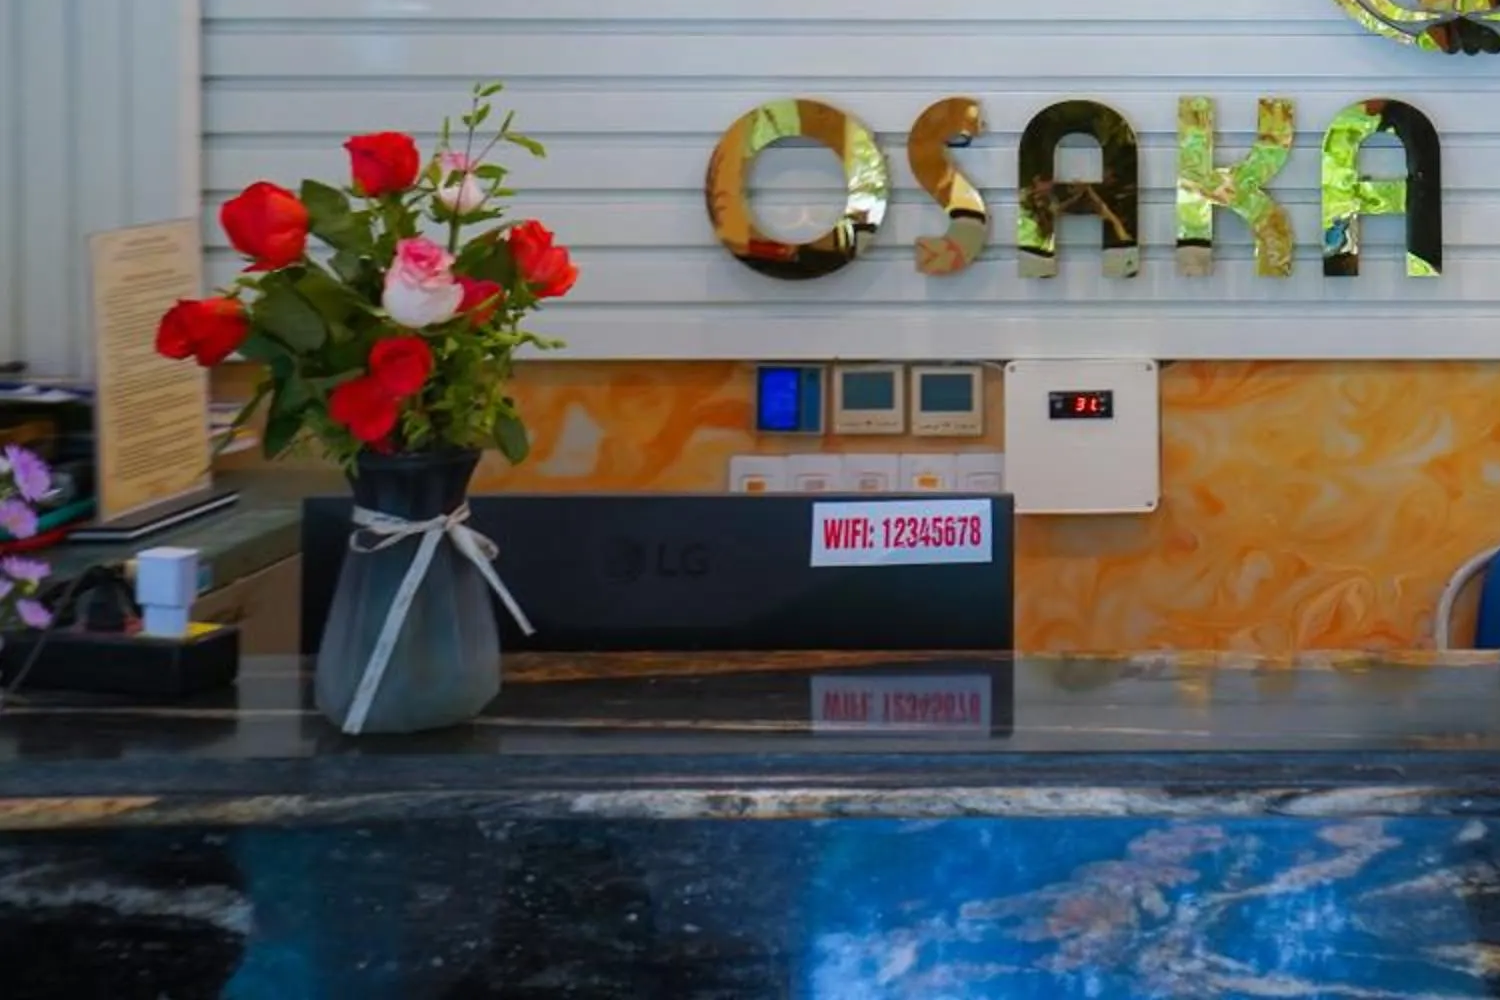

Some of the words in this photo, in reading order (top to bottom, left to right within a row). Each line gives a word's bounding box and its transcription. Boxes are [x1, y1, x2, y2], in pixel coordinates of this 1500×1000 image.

[705, 96, 1443, 280] OSAKA
[823, 519, 875, 549] WIFI:
[882, 515, 982, 549] 12345678
[656, 542, 711, 577] LG
